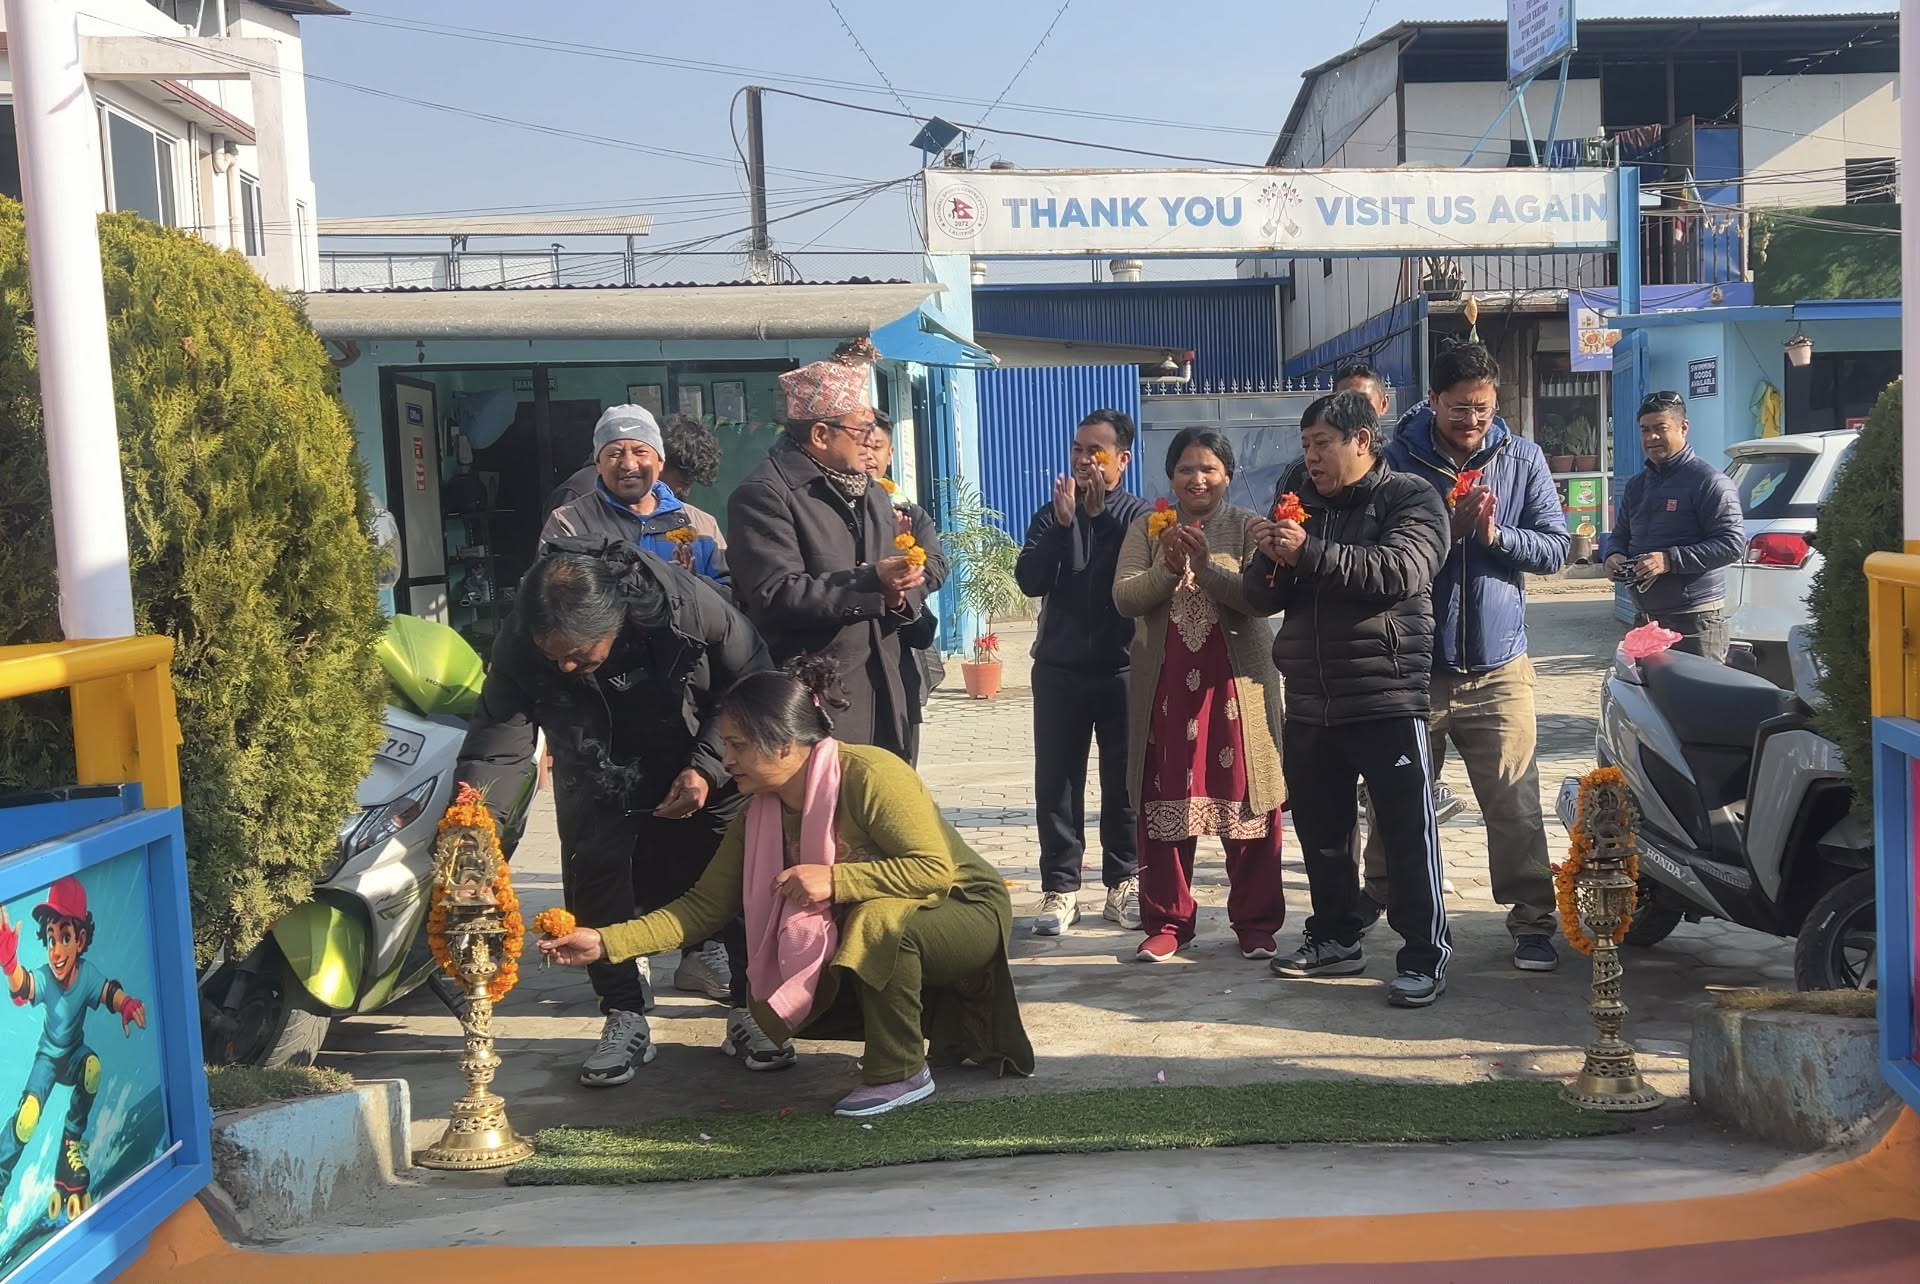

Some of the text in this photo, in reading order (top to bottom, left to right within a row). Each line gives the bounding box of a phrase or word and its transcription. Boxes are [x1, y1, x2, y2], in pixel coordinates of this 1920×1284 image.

[1002, 193, 1608, 228] THANK YOU VISIT US AGAIN
[1694, 370, 1712, 380] GOODS
[1691, 378, 1715, 387] AVAILABLE
[1696, 386, 1710, 394] HERE
[1646, 847, 1682, 880] HONDA
